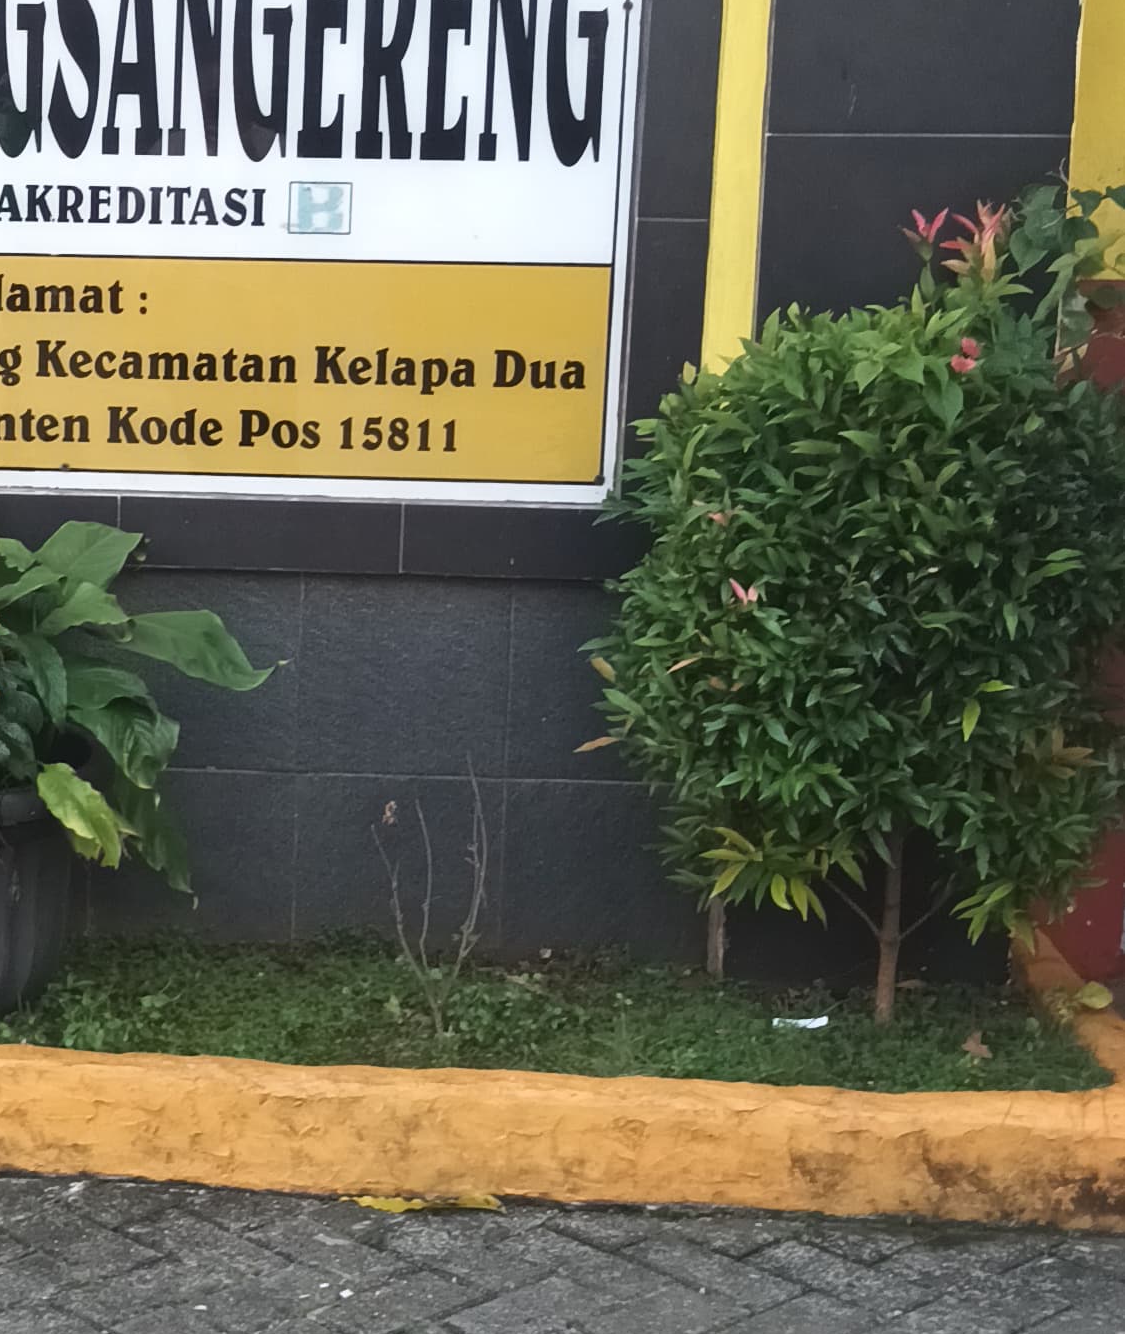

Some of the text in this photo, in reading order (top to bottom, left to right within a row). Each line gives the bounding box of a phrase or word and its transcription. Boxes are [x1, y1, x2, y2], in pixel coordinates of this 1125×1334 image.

[139, 292, 148, 315] :
[36, 339, 297, 384] Kecamatan
[313, 345, 475, 396] Kelapa
[493, 349, 586, 390] Dua
[106, 406, 223, 447] Kode
[238, 409, 321, 450] Pos
[340, 416, 457, 452] 15811
